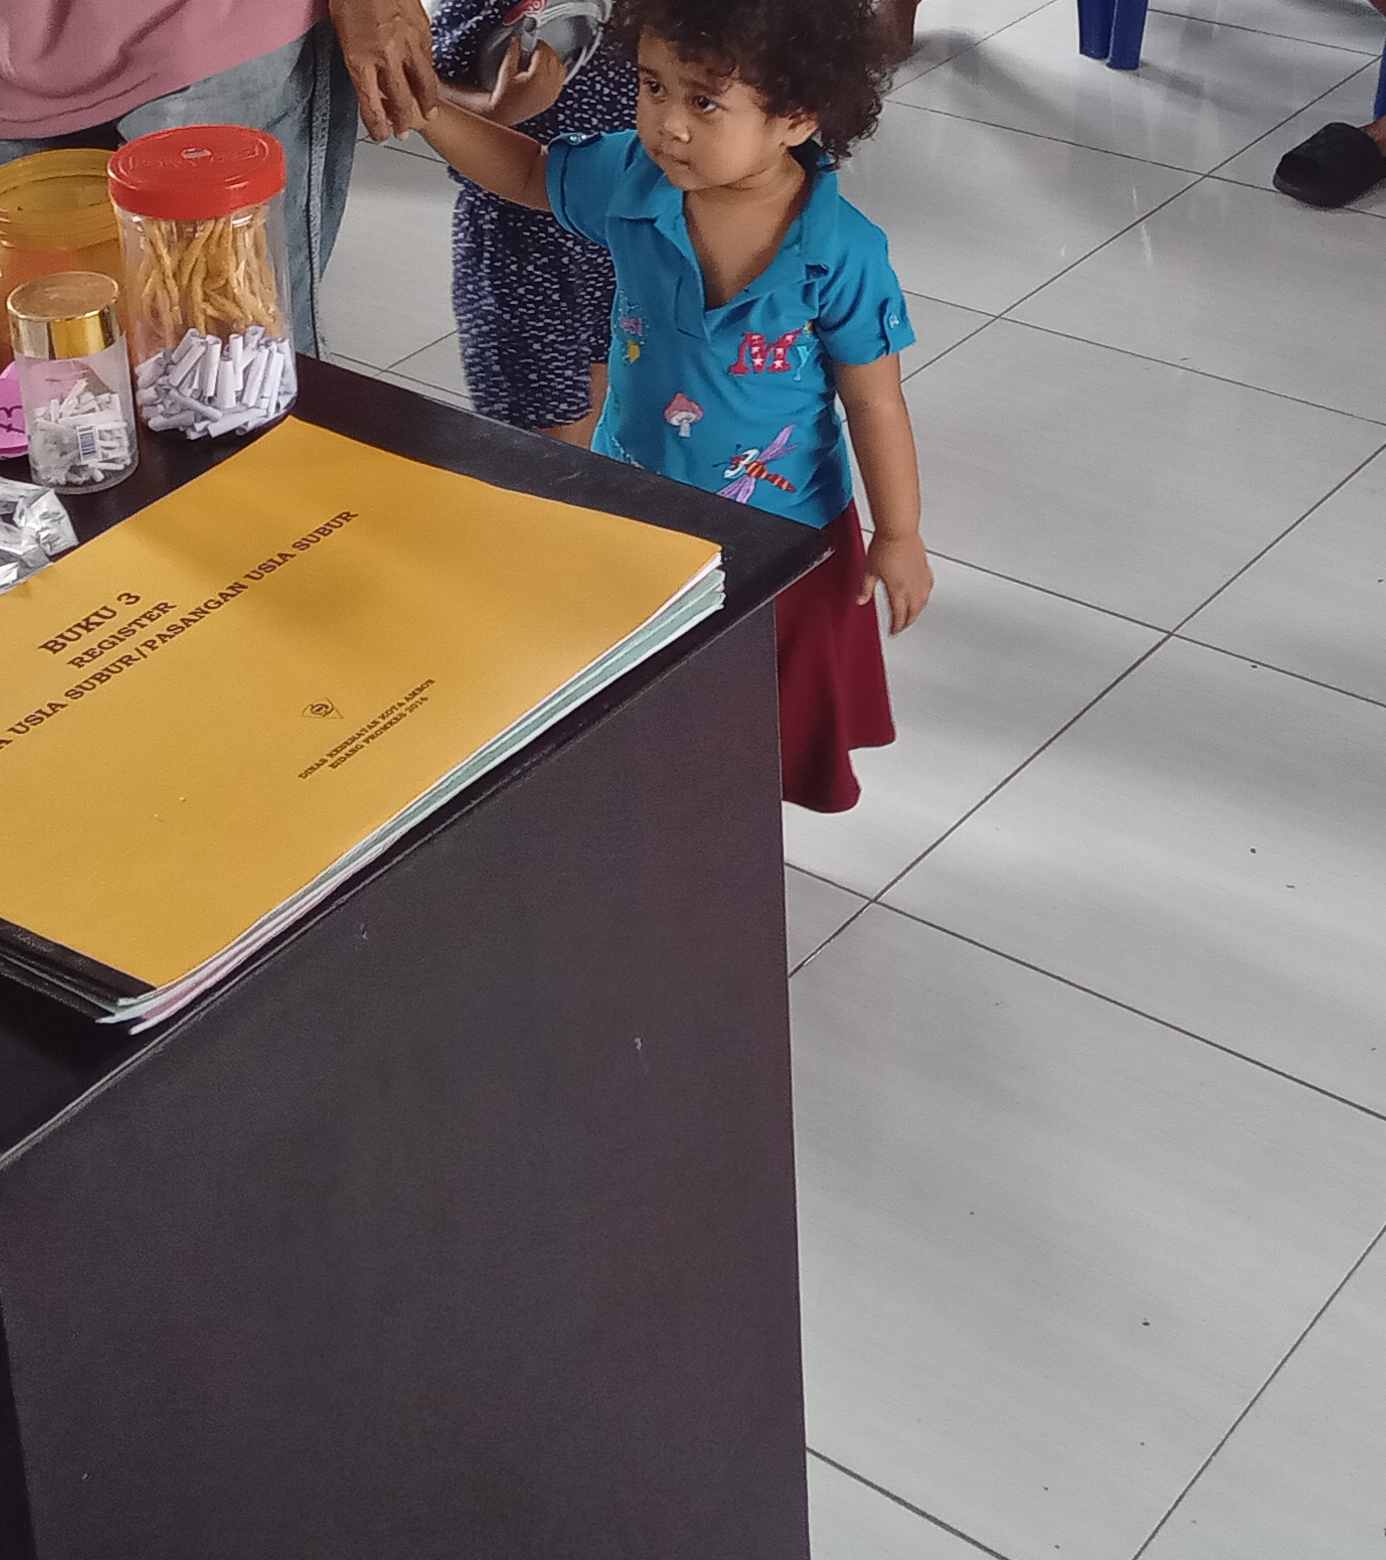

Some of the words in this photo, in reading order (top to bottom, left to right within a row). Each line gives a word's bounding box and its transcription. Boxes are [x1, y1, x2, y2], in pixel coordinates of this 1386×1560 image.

[7, 701, 69, 734] USIA
[64, 581, 249, 700] SUBUR/PASANGAN
[243, 550, 297, 581] USIA
[291, 510, 359, 551] SUBUR
[37, 605, 118, 655] BUKU
[116, 592, 142, 606] 3
[66, 601, 177, 669] REGISTER
